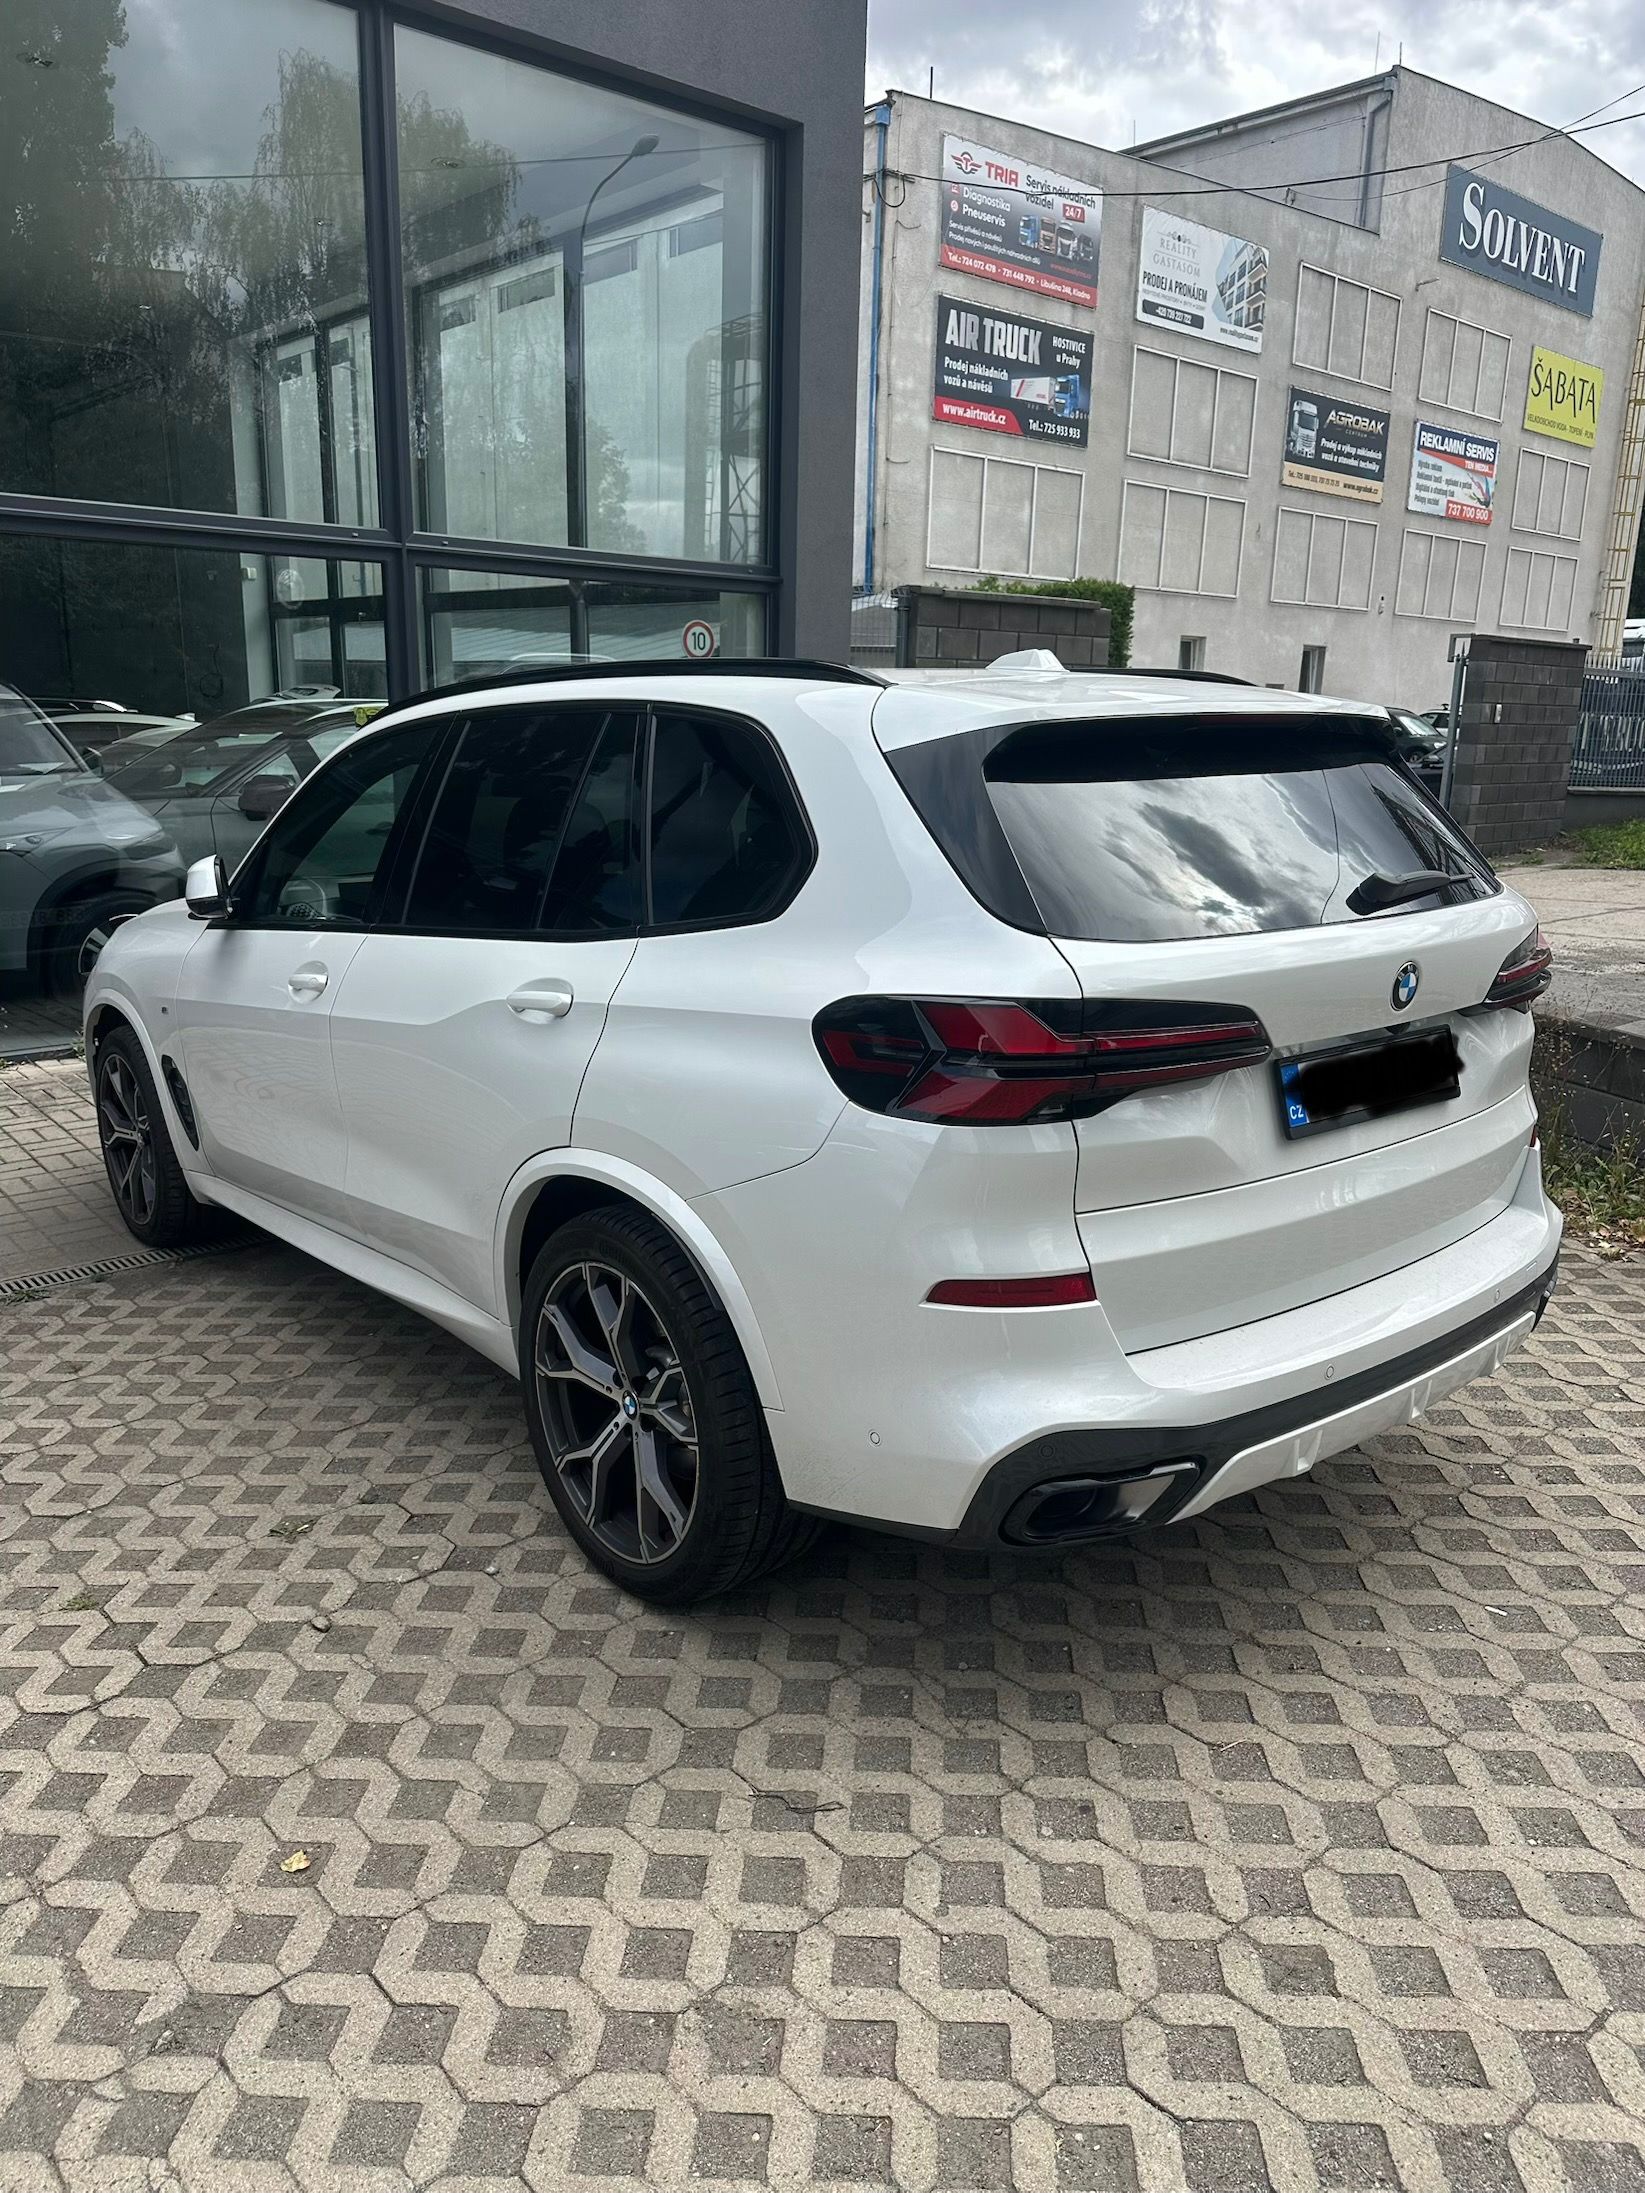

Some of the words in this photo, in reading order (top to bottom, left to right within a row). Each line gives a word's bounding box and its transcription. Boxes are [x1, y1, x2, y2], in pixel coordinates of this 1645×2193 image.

[985, 161, 1019, 187] TRIA
[1026, 174, 1051, 193] Servis
[963, 186, 1011, 212] Diagnostika
[1025, 193, 1054, 210] vozidel
[963, 203, 1006, 227] Pneuservis
[1065, 206, 1082, 219] 24/7
[1459, 182, 1585, 293] SOLVENT
[1160, 238, 1197, 259] REALITY
[1143, 270, 1167, 291] PRODEJ
[1168, 279, 1173, 293] A
[1174, 282, 1208, 303] PRONÁJEM
[945, 308, 980, 351] AIR
[983, 318, 1042, 366] TRUCK
[1052, 336, 1086, 354] HOSTIVICE
[944, 356, 969, 375] Prodej
[969, 361, 1009, 381] nákladních
[1056, 354, 1061, 363] u
[1062, 353, 1081, 370] Prahy
[943, 374, 961, 387] vozů
[962, 380, 967, 388] a
[968, 378, 994, 394] návěsů
[1531, 357, 1595, 423] ŠABATA
[942, 403, 1007, 425] www.airtruck.cz
[1323, 409, 1385, 435] AGROBAK
[1029, 419, 1043, 432] Tel.:
[1043, 422, 1056, 434] 725
[1056, 424, 1068, 437] 933
[1068, 426, 1081, 439] 933
[1420, 431, 1466, 455] REKLAMNÍ
[1466, 442, 1494, 462] SERVIS
[1448, 503, 1461, 516] 737
[1462, 506, 1475, 518] 700
[1475, 508, 1489, 520] 900
[692, 632, 706, 651] 10
[1289, 1104, 1305, 1120] CZ
